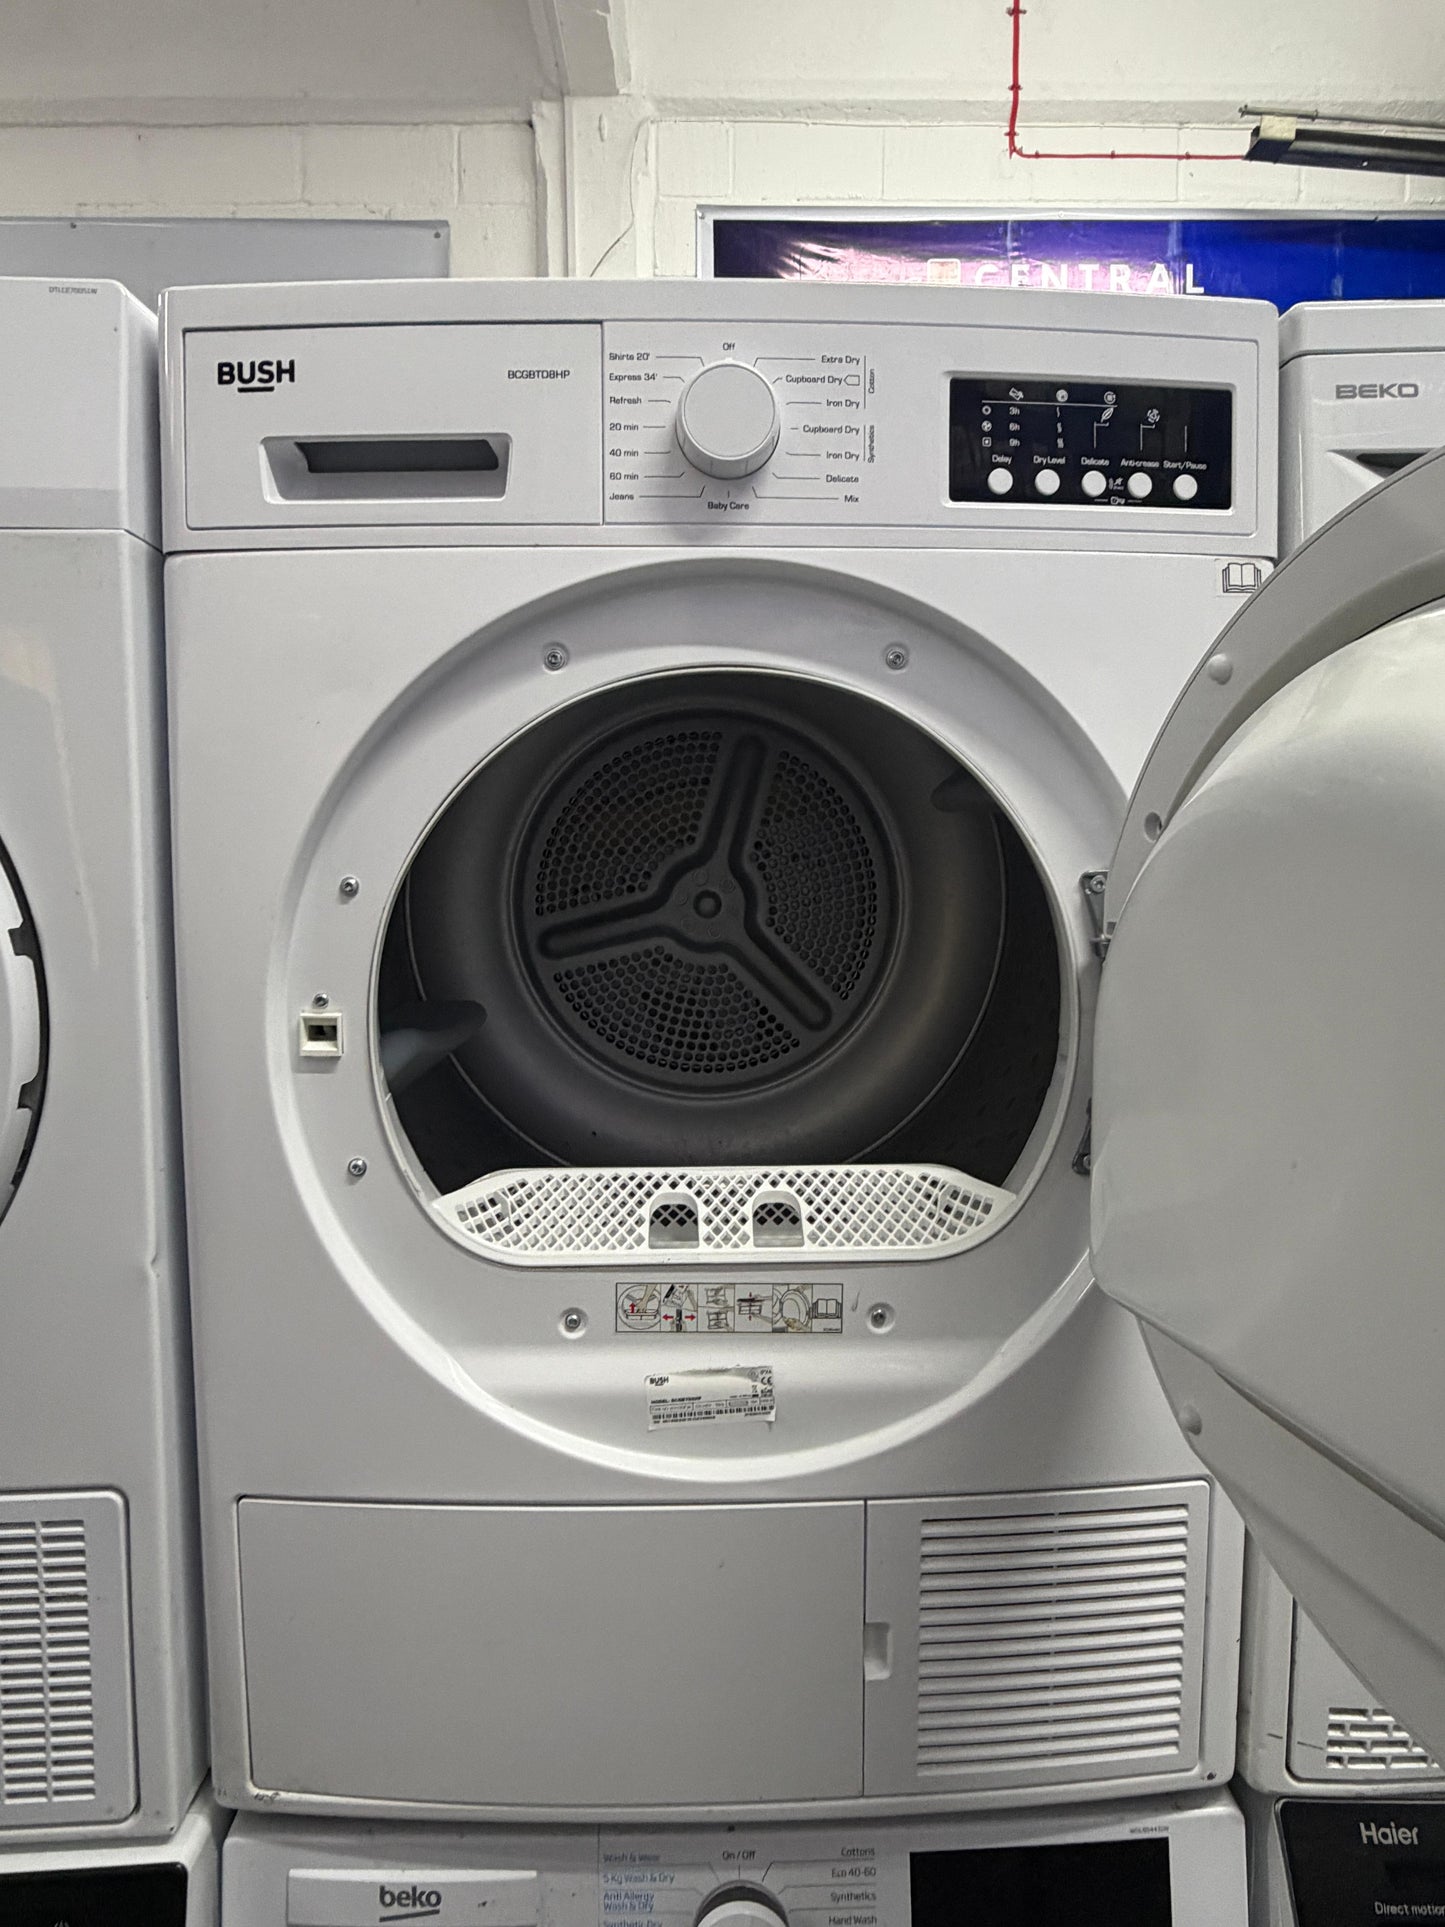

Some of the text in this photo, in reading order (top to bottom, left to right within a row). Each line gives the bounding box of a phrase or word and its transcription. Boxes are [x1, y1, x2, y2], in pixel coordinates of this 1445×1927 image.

[975, 262, 1204, 294] CENTRAL
[722, 342, 735, 351] Off
[609, 352, 634, 361] Shirts
[821, 355, 860, 365] Extra Dry
[217, 359, 295, 386] BUSH
[609, 373, 641, 382] Express
[785, 374, 843, 385] Cupboard Dry
[1336, 383, 1419, 399] BEKO
[609, 396, 641, 404] Refresh
[826, 399, 860, 409] Iron Dry
[1009, 407, 1020, 416] 3h
[609, 423, 638, 431] 20 min
[802, 425, 860, 435] Cupboard Dry
[1009, 438, 1020, 447] 9h
[609, 449, 638, 457] 40 min
[826, 451, 860, 461] Iron Dry
[992, 454, 1012, 464] Delay
[1033, 455, 1066, 465] Dry Level
[1081, 457, 1110, 466] Delicate
[609, 472, 638, 480] 60 min
[825, 475, 859, 483] Delicate
[609, 492, 634, 500] Jeans
[844, 495, 859, 503] Mix
[707, 501, 749, 511] Baby Care
[1360, 1822, 1418, 1845] Haier
[840, 1846, 875, 1858] Cottons
[831, 1866, 877, 1877] Eco 40-60
[625, 1873, 648, 1883] Wash
[658, 1872, 675, 1884] Dry
[380, 1885, 441, 1908] beko
[830, 1890, 877, 1902] Synthetics
[1375, 1902, 1409, 1915] Direct
[828, 1914, 877, 1926] Hand Wash
